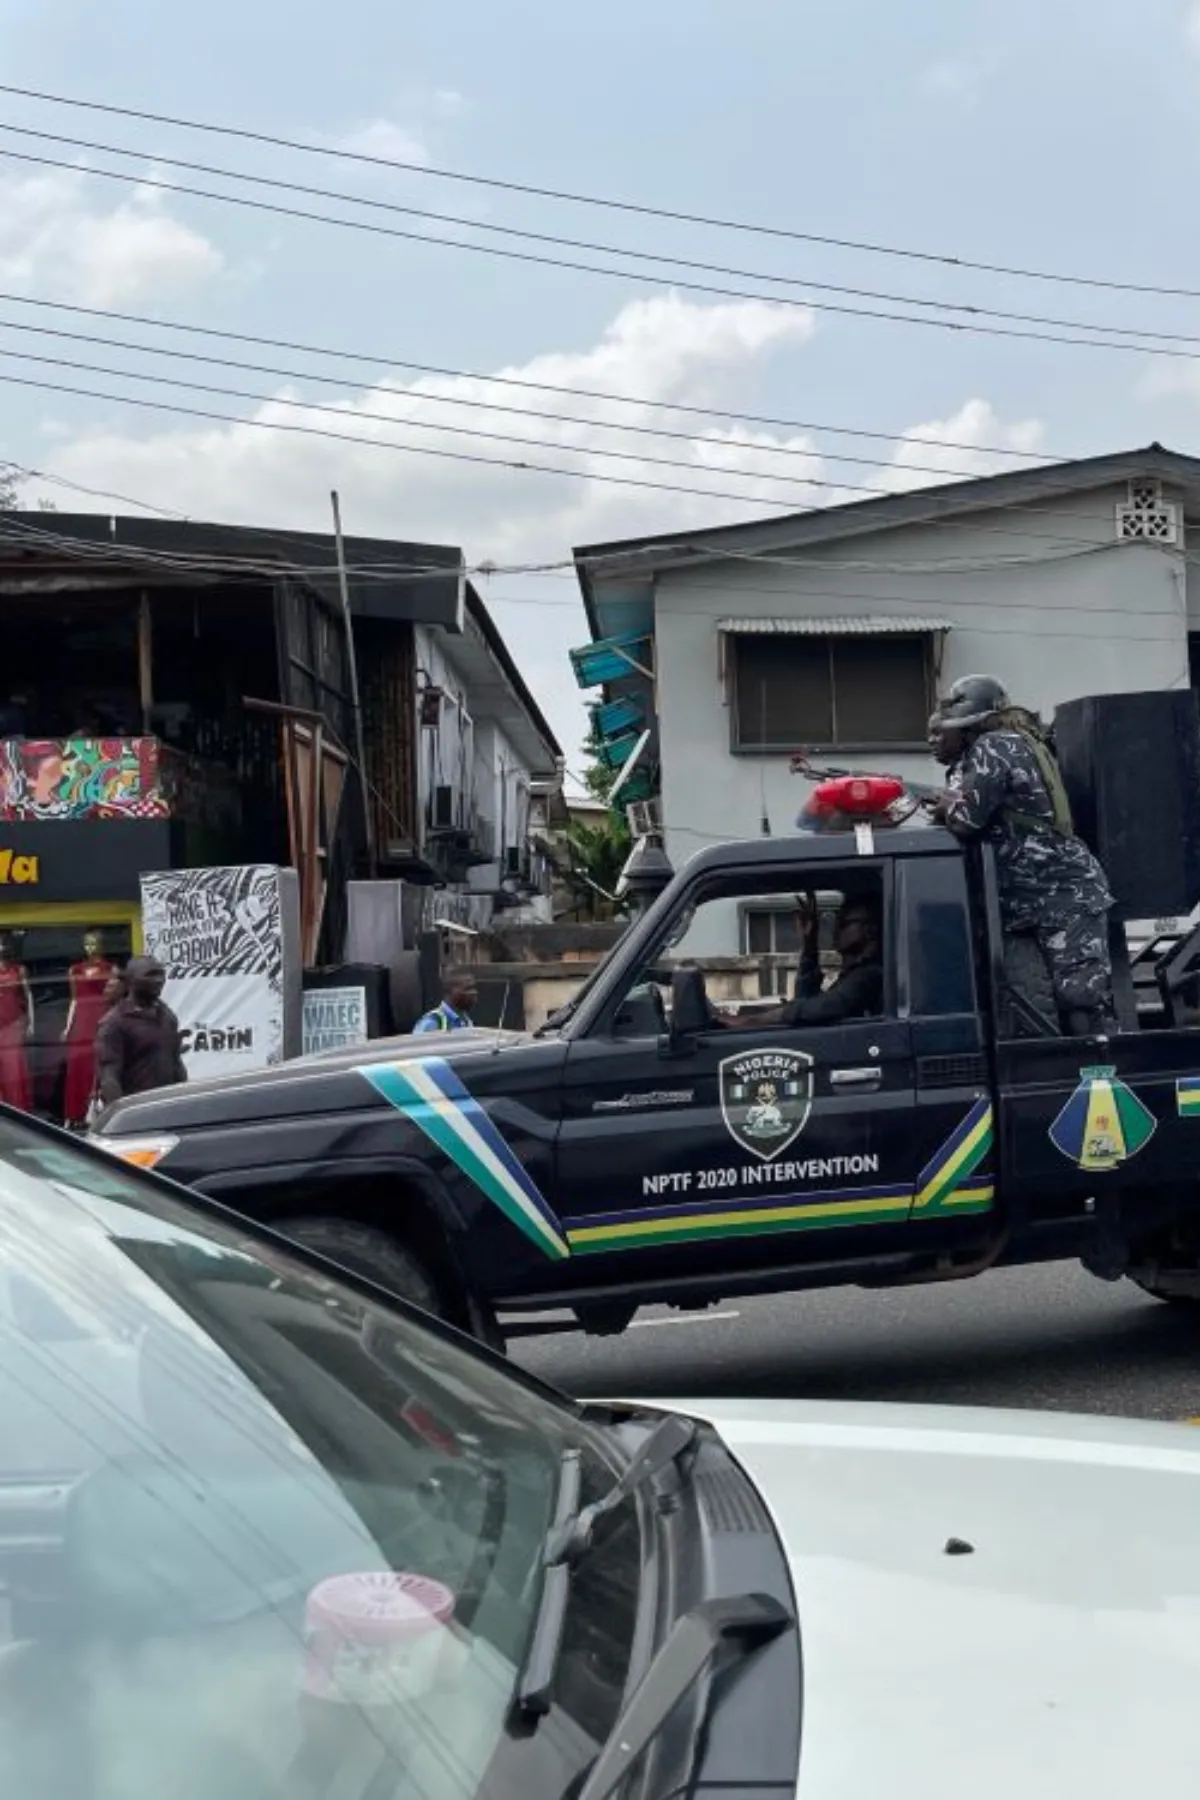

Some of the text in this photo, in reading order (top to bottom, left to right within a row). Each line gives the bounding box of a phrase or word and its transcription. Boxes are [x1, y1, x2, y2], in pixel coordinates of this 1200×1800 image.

[304, 1003, 361, 1029] WAEC
[733, 1055, 800, 1076] NIGERIA
[742, 1068, 790, 1083] POLICE
[642, 1153, 879, 1195] NPTF 2020 INTERVENTION
